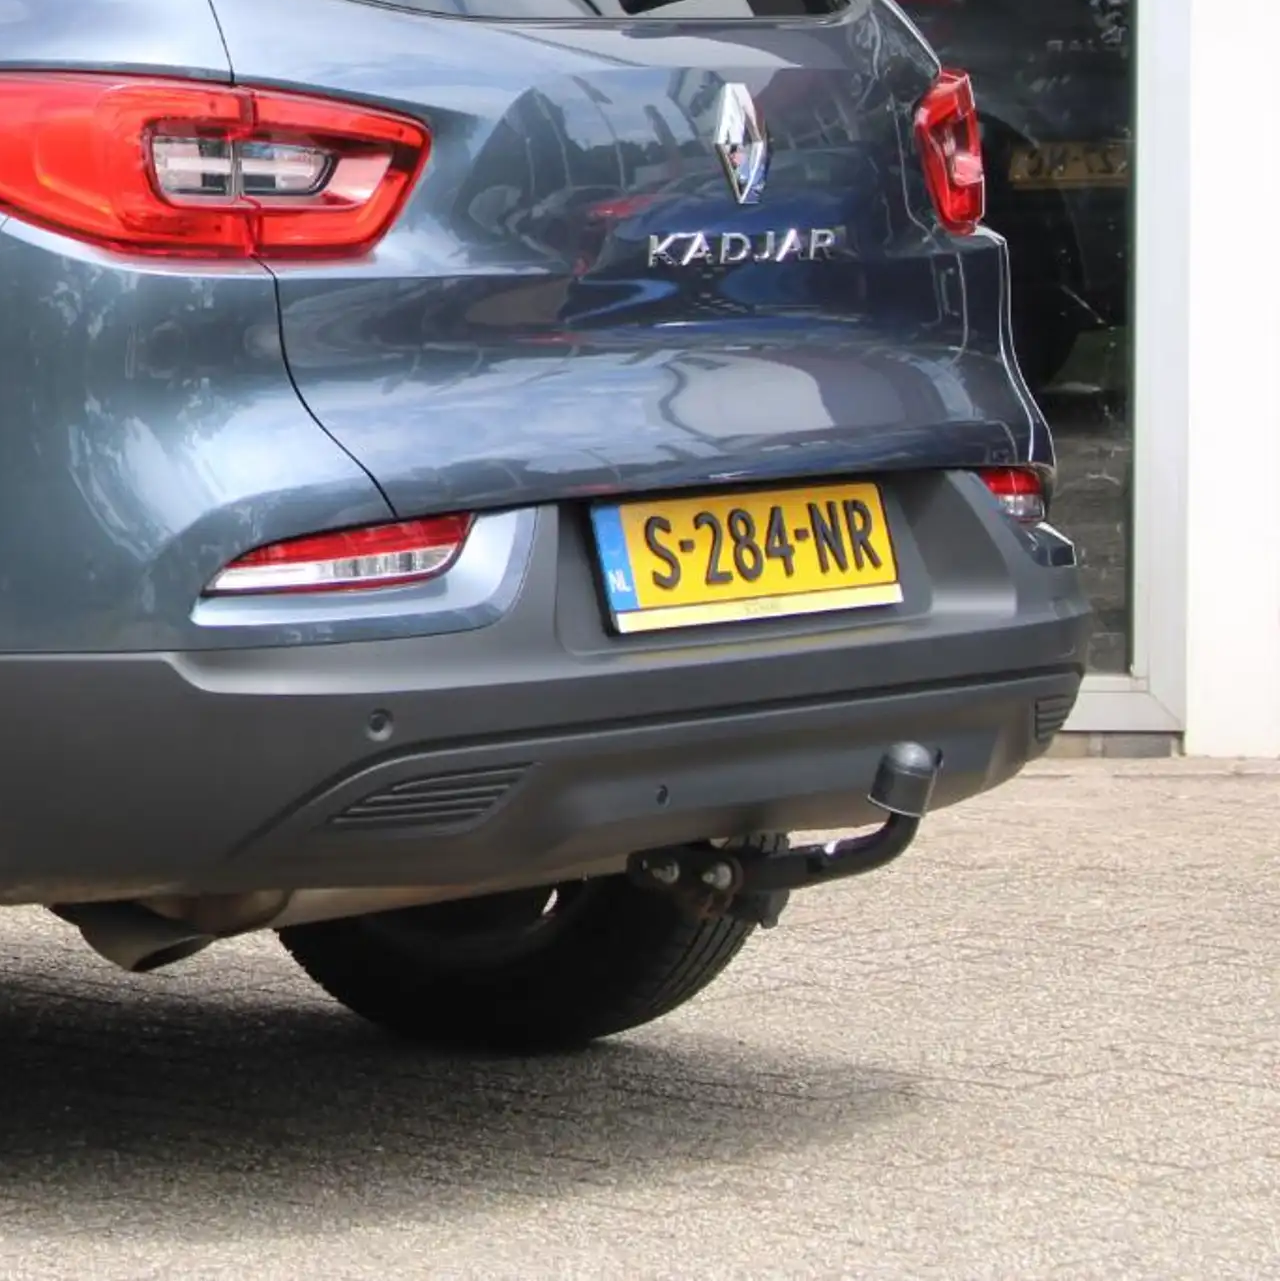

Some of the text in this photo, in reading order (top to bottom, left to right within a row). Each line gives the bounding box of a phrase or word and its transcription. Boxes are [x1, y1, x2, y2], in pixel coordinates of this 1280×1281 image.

[648, 227, 836, 268] KADJAR
[643, 499, 883, 591] S-284-NR
[608, 571, 631, 593] NL
